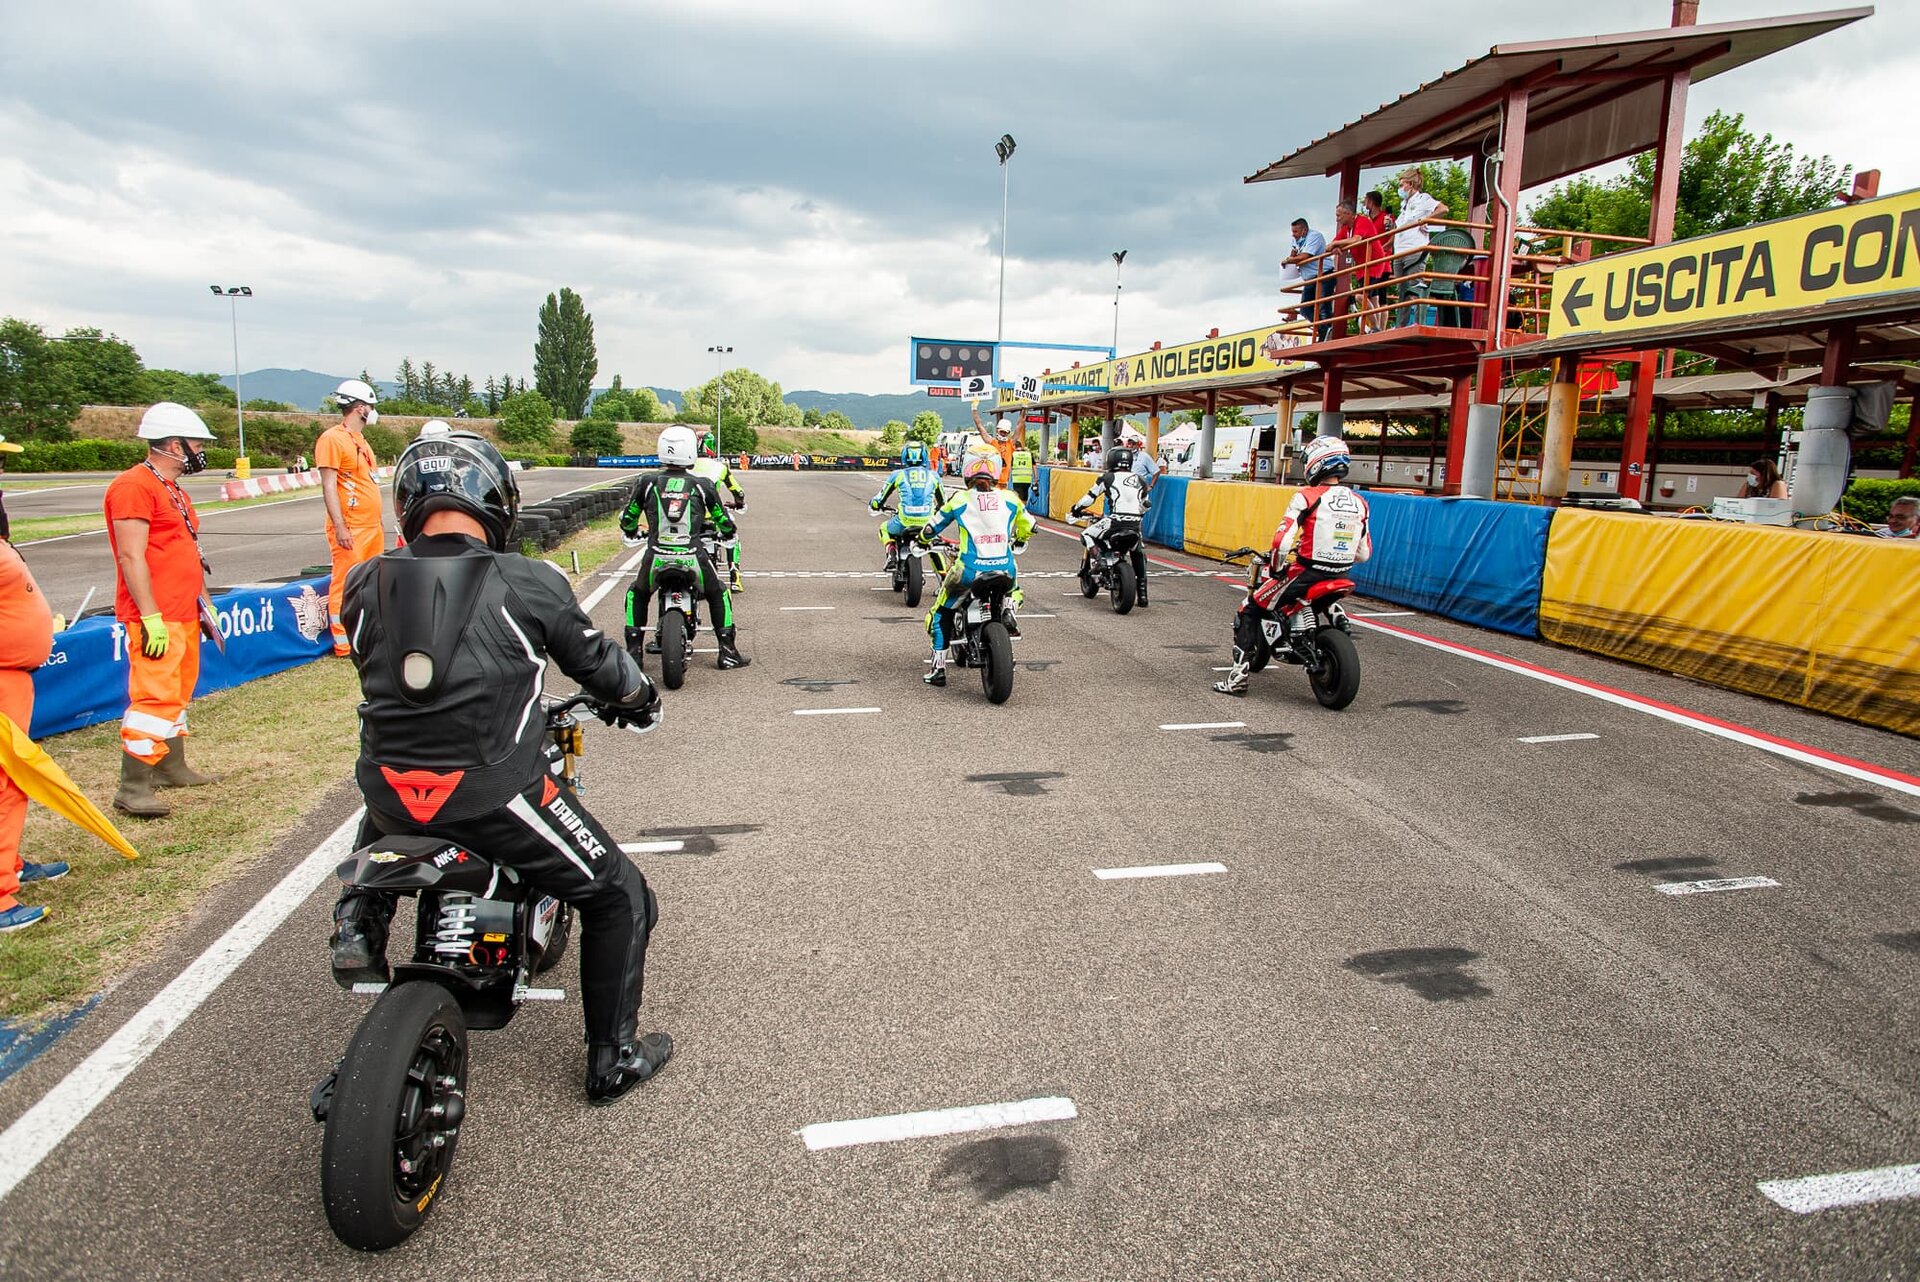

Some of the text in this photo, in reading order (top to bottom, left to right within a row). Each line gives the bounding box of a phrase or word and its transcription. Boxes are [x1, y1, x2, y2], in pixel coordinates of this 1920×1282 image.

[1603, 240, 1776, 322] USCITA
[1134, 341, 1256, 382] A NOLEGGIO
[1021, 376, 1037, 392] 30
[1015, 389, 1040, 402] SECONDI
[423, 459, 447, 472] agv
[908, 470, 927, 483] 90
[977, 494, 999, 511] 12
[547, 797, 607, 860] DAINESE
